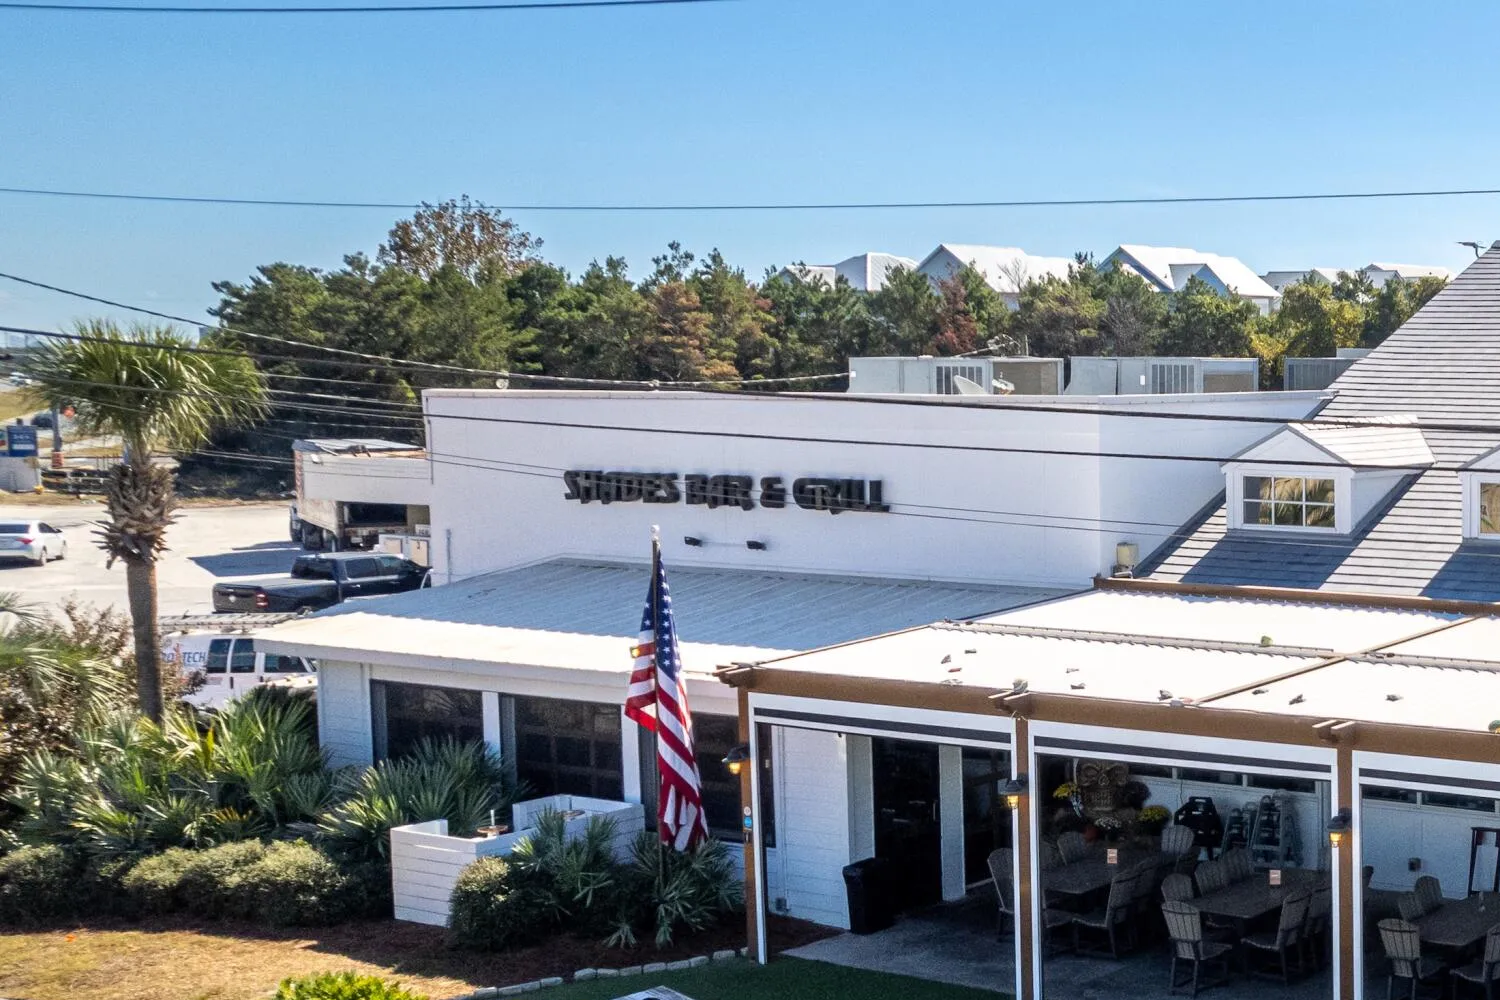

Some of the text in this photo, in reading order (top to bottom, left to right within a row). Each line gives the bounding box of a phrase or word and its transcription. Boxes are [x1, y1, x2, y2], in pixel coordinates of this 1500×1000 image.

[563, 469, 890, 514] SHADES BAR & GRILL
